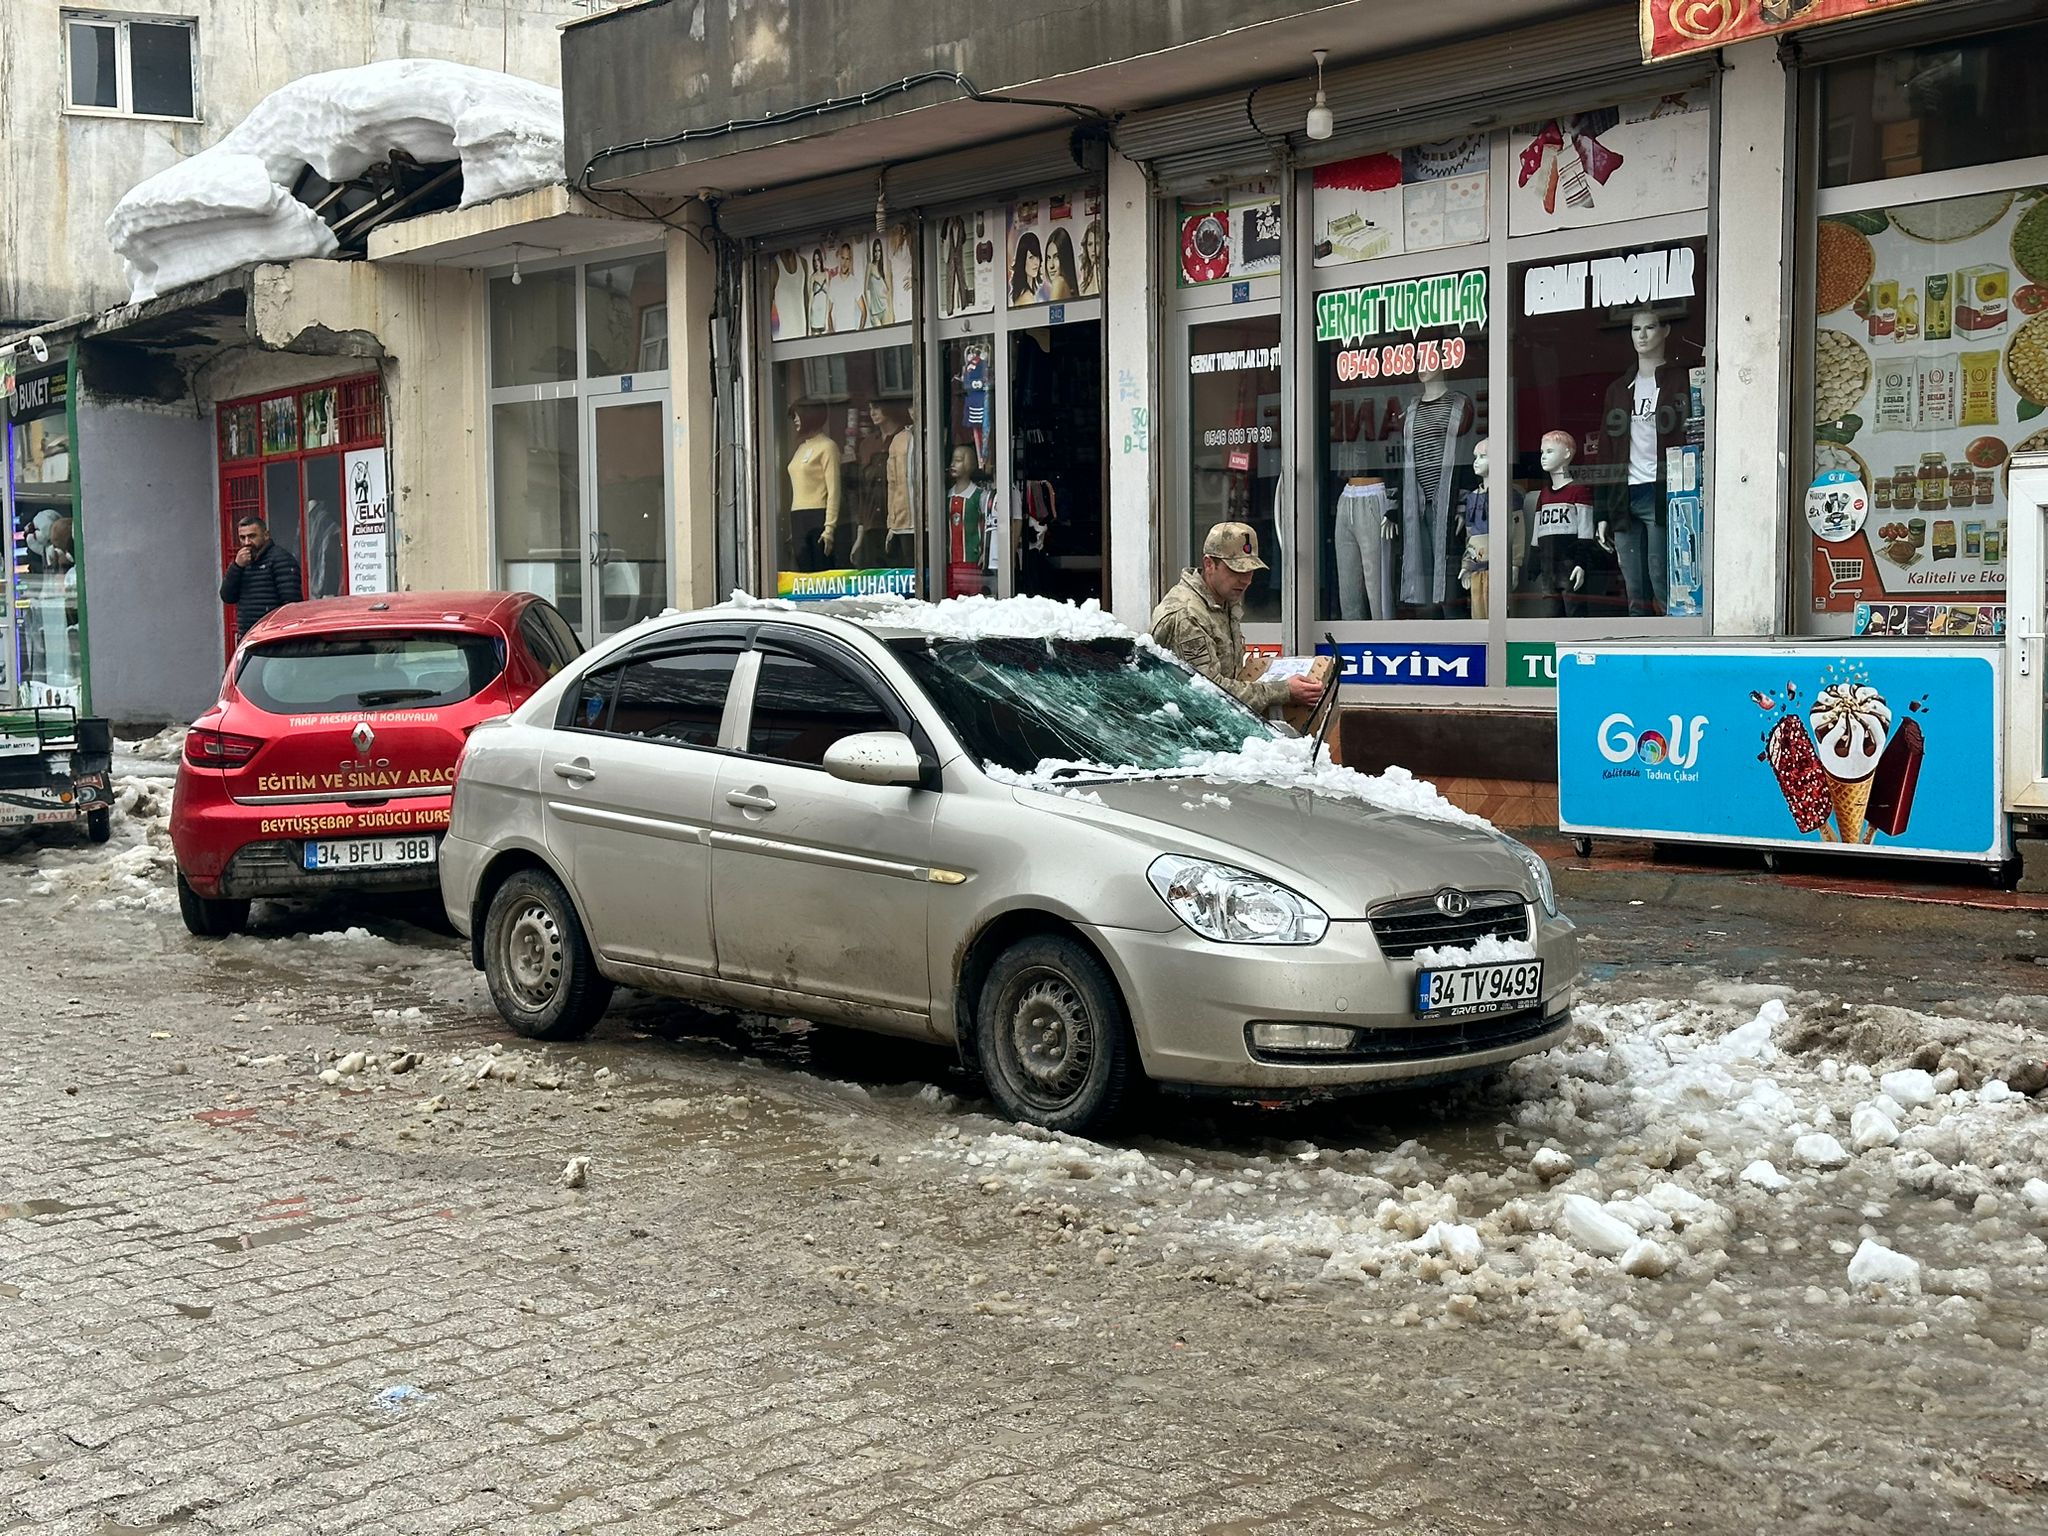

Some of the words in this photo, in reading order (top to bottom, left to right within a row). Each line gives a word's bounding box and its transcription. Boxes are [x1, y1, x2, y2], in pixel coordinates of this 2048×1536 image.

[1317, 285, 1382, 348] SERHAT
[1383, 270, 1488, 339] TURGUTLAR
[1337, 348, 1380, 381] 0546
[1382, 343, 1416, 377] 868
[1418, 339, 1440, 373] 76
[1441, 337, 1466, 370] 39
[19, 376, 49, 410] BUKET
[1204, 430, 1227, 446] 0546
[1228, 429, 1246, 445] 868
[1247, 427, 1259, 443] 76
[1260, 426, 1273, 442] 39
[1539, 508, 1571, 525] OCK
[792, 576, 846, 595] ATAMAN
[1907, 572, 1956, 584] Kaliteli
[1960, 573, 1976, 583] ve
[1340, 650, 1471, 678] GİYİM
[289, 715, 317, 727] TAKİP
[319, 711, 379, 725] MESAFESİNİ
[380, 713, 438, 723] KORUYALIM
[1597, 712, 1710, 769] Golf
[339, 758, 390, 769] CLIO
[320, 774, 344, 788] VE
[348, 770, 402, 787] SINAV
[1645, 768, 1672, 780] Tadını
[1673, 770, 1699, 783] Çıkar!
[260, 815, 354, 834] BEYTÜŞŞEBAP
[358, 808, 412, 827] SÜRÜCÜ
[415, 810, 451, 825] KURS
[308, 856, 317, 864] TR
[317, 844, 341, 864] 34
[349, 842, 384, 863] BFU
[395, 840, 430, 860] 388
[1430, 973, 1455, 1006] 34
[1460, 969, 1490, 1002] TV
[1490, 966, 1539, 999] 9493
[1420, 993, 1429, 1003] TR
[1478, 1003, 1497, 1013] OTO
